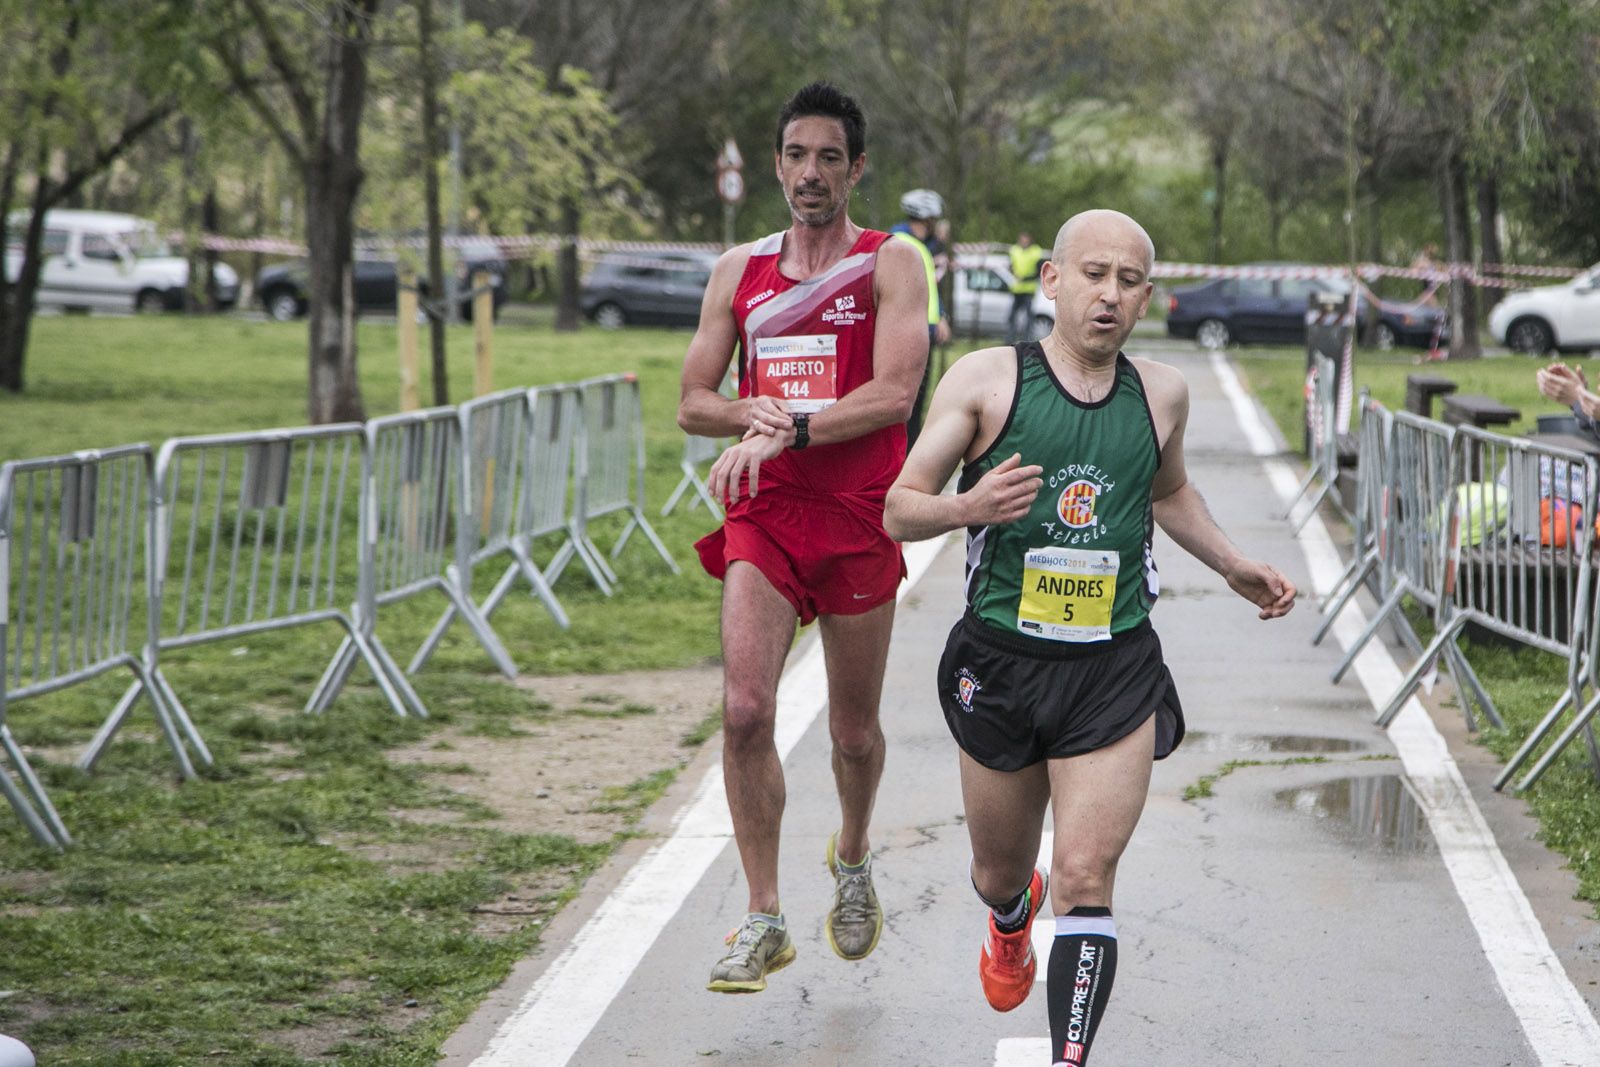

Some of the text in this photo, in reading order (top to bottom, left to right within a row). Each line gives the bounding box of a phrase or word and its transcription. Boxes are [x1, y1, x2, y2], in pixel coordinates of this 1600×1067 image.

[766, 360, 825, 377] ALBERTO
[781, 381, 810, 398] 144
[1036, 575, 1104, 598] ANDRES
[1063, 603, 1074, 622] 5
